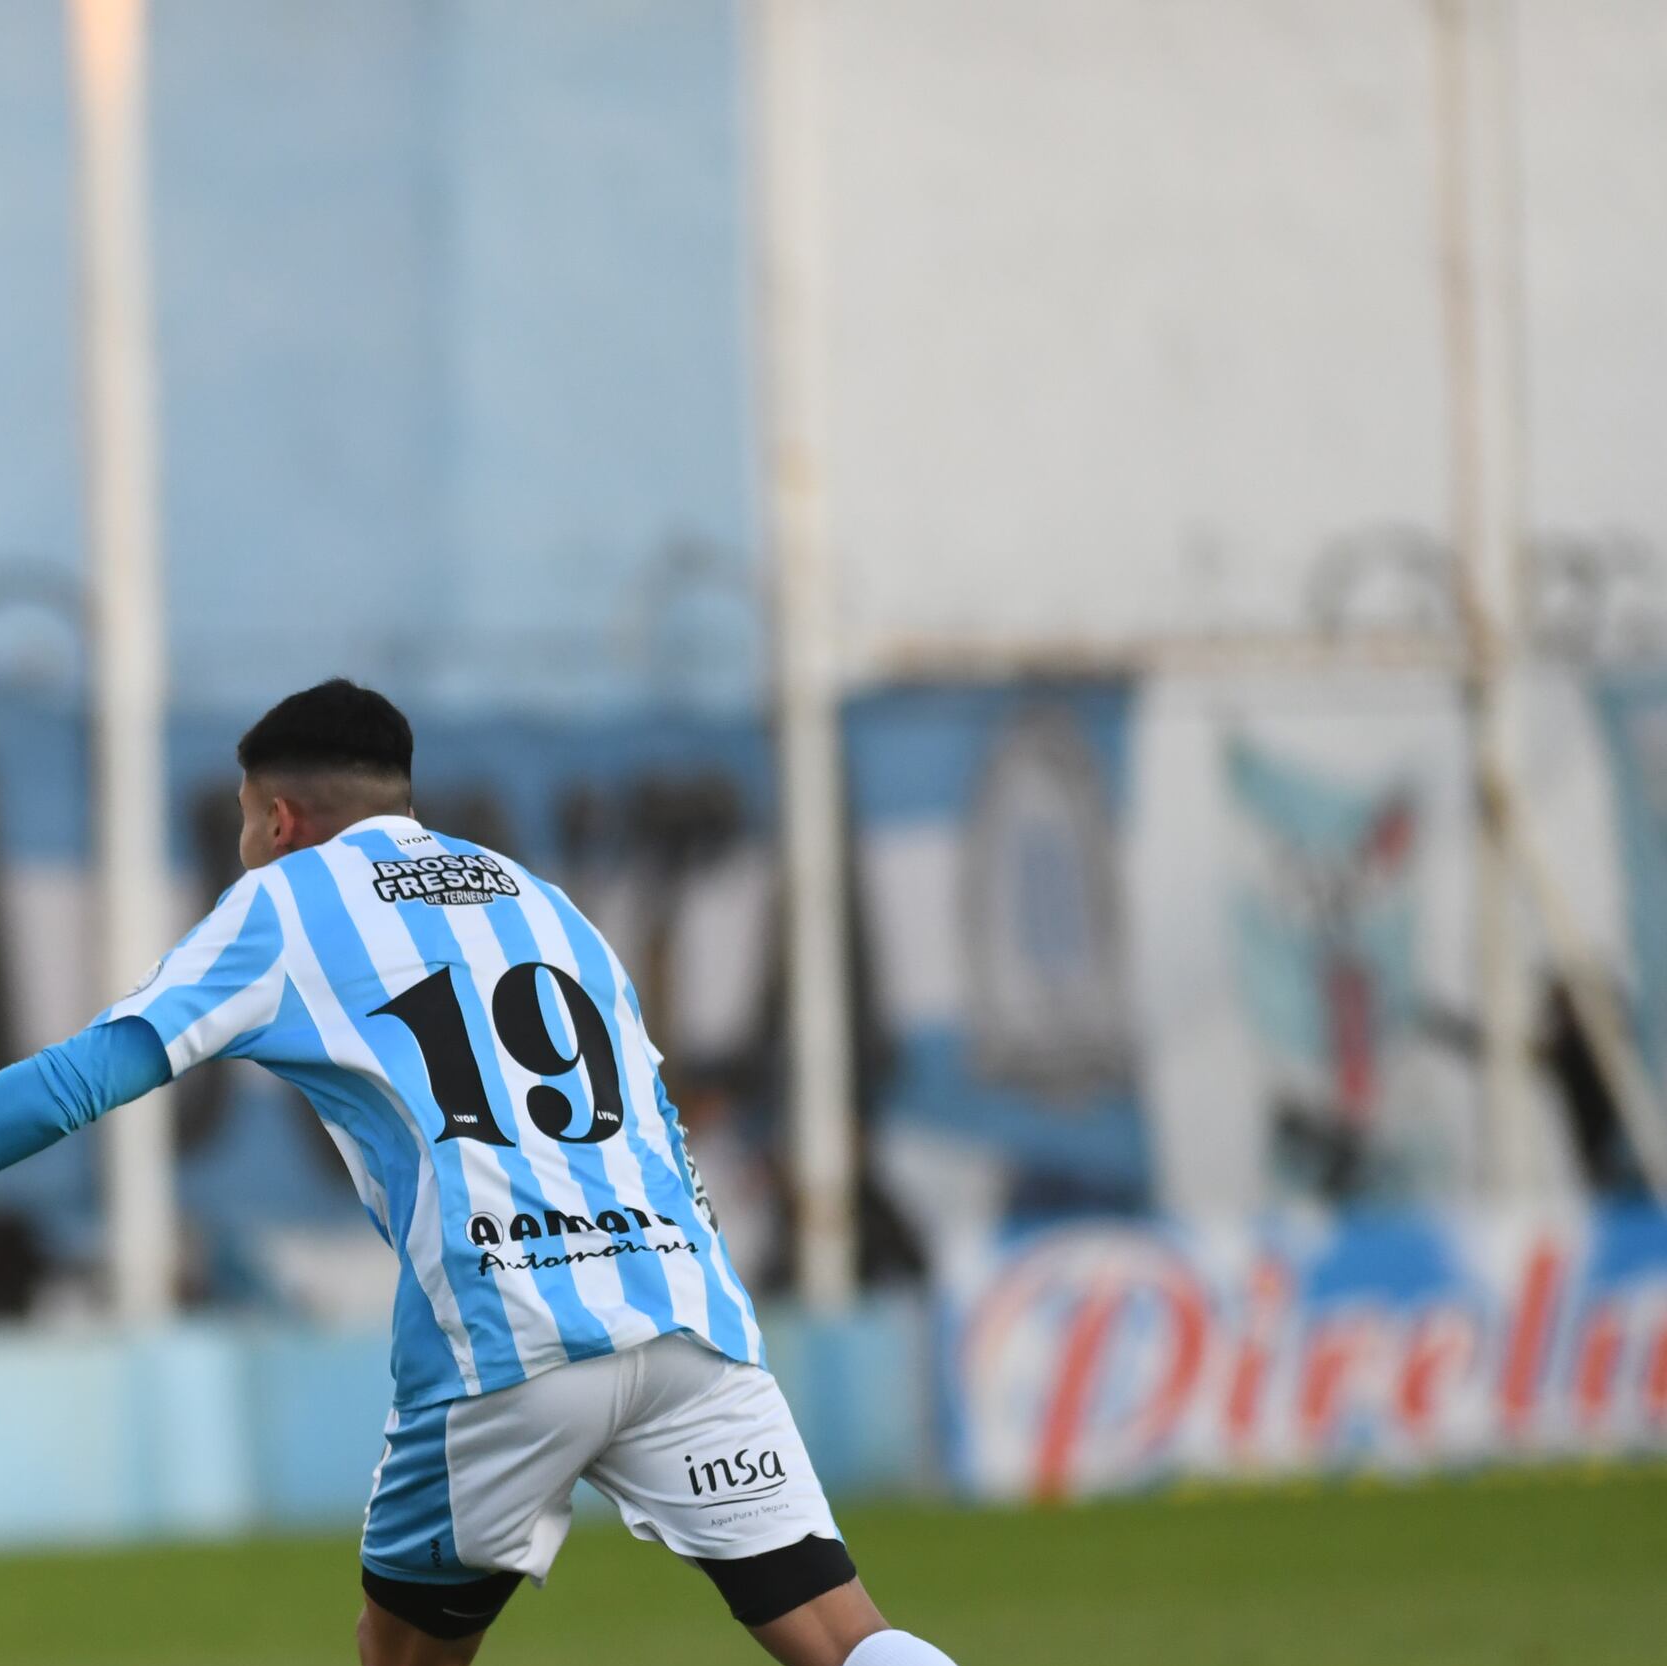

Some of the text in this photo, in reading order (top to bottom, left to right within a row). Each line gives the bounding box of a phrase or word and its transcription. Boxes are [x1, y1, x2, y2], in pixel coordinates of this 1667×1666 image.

[397, 834, 433, 846] LYON
[377, 856, 500, 878] BROSAS
[378, 870, 518, 900] FRESCAS
[425, 891, 492, 905] DE TERNERA
[365, 962, 624, 1148] 19
[453, 1114, 478, 1124] LYON
[597, 1110, 619, 1122] LYON
[685, 1448, 785, 1496] insa
